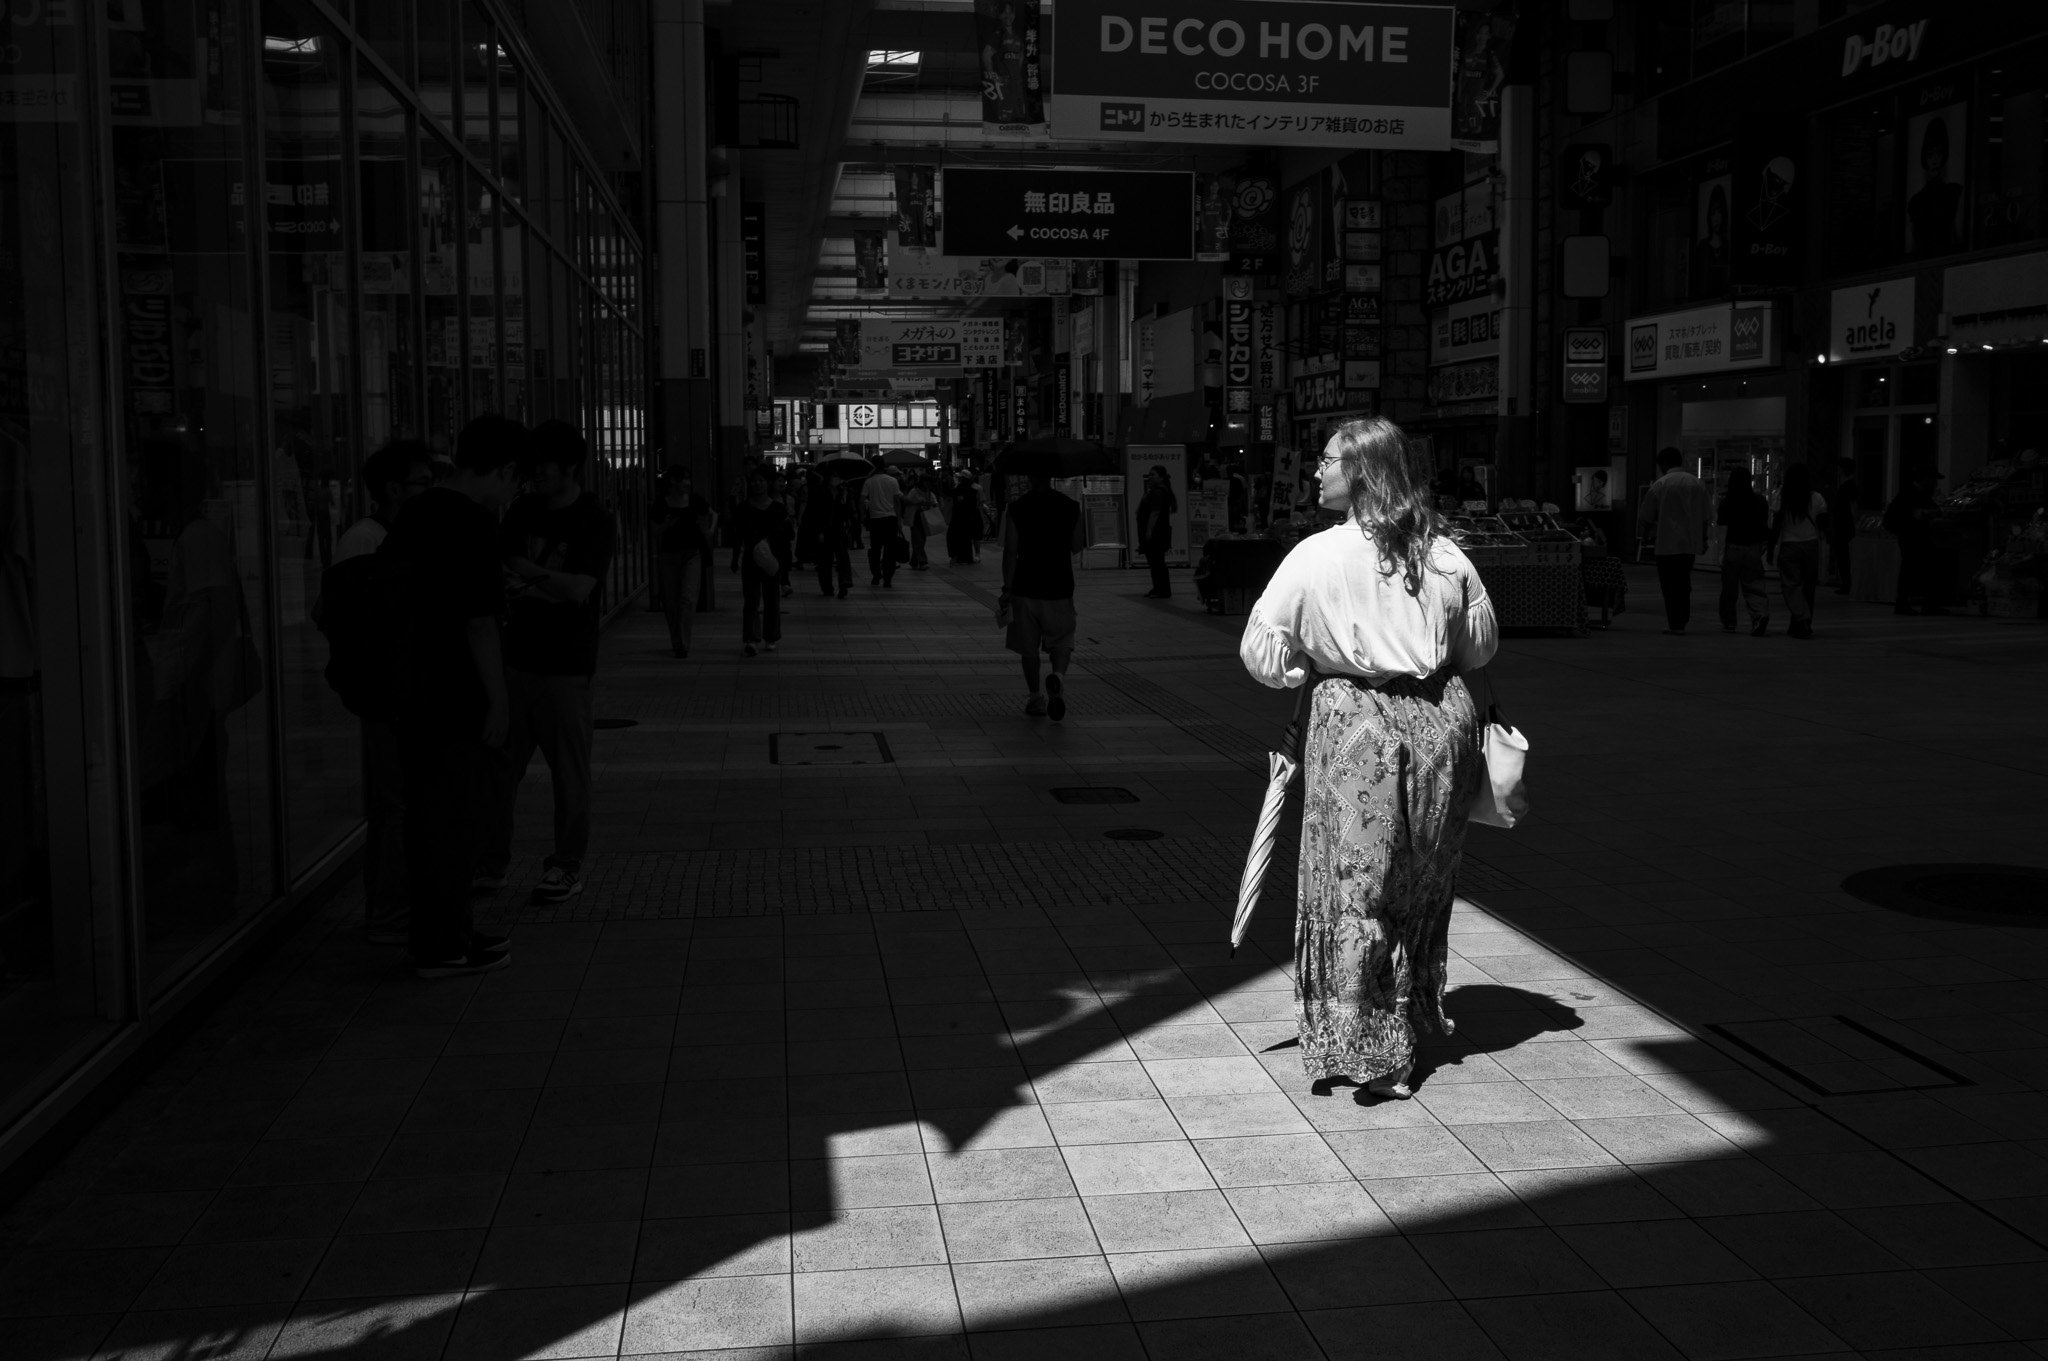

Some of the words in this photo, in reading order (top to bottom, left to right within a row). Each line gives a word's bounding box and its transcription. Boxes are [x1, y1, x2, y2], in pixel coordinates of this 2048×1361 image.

[1100, 15, 1246, 58] DECO
[1260, 21, 1409, 64] HOME
[1841, 18, 1930, 77] D-Boy
[1195, 72, 1290, 93] COCOSA
[1297, 76, 1320, 94] 3F
[1103, 107, 1141, 127] ニトリ
[1150, 110, 1405, 136] から生まれたインテリア雑貨のお店
[1024, 191, 1115, 215] 無印良品
[1030, 227, 1088, 241] COCOSA
[1092, 228, 1110, 241] 4F
[1750, 242, 1789, 257] D-Boy
[1242, 258, 1263, 270] 2F
[1428, 240, 1489, 286] AGA
[1349, 298, 1378, 309] AGA
[899, 326, 956, 341] メガネの
[1229, 303, 1250, 382] シモカワ
[1846, 316, 1896, 345] anela
[897, 345, 957, 361] ヨネザワ
[1261, 302, 1274, 388] 処方せん受付
[963, 355, 998, 365] 下通店
[1260, 405, 1273, 441] 化粧品
